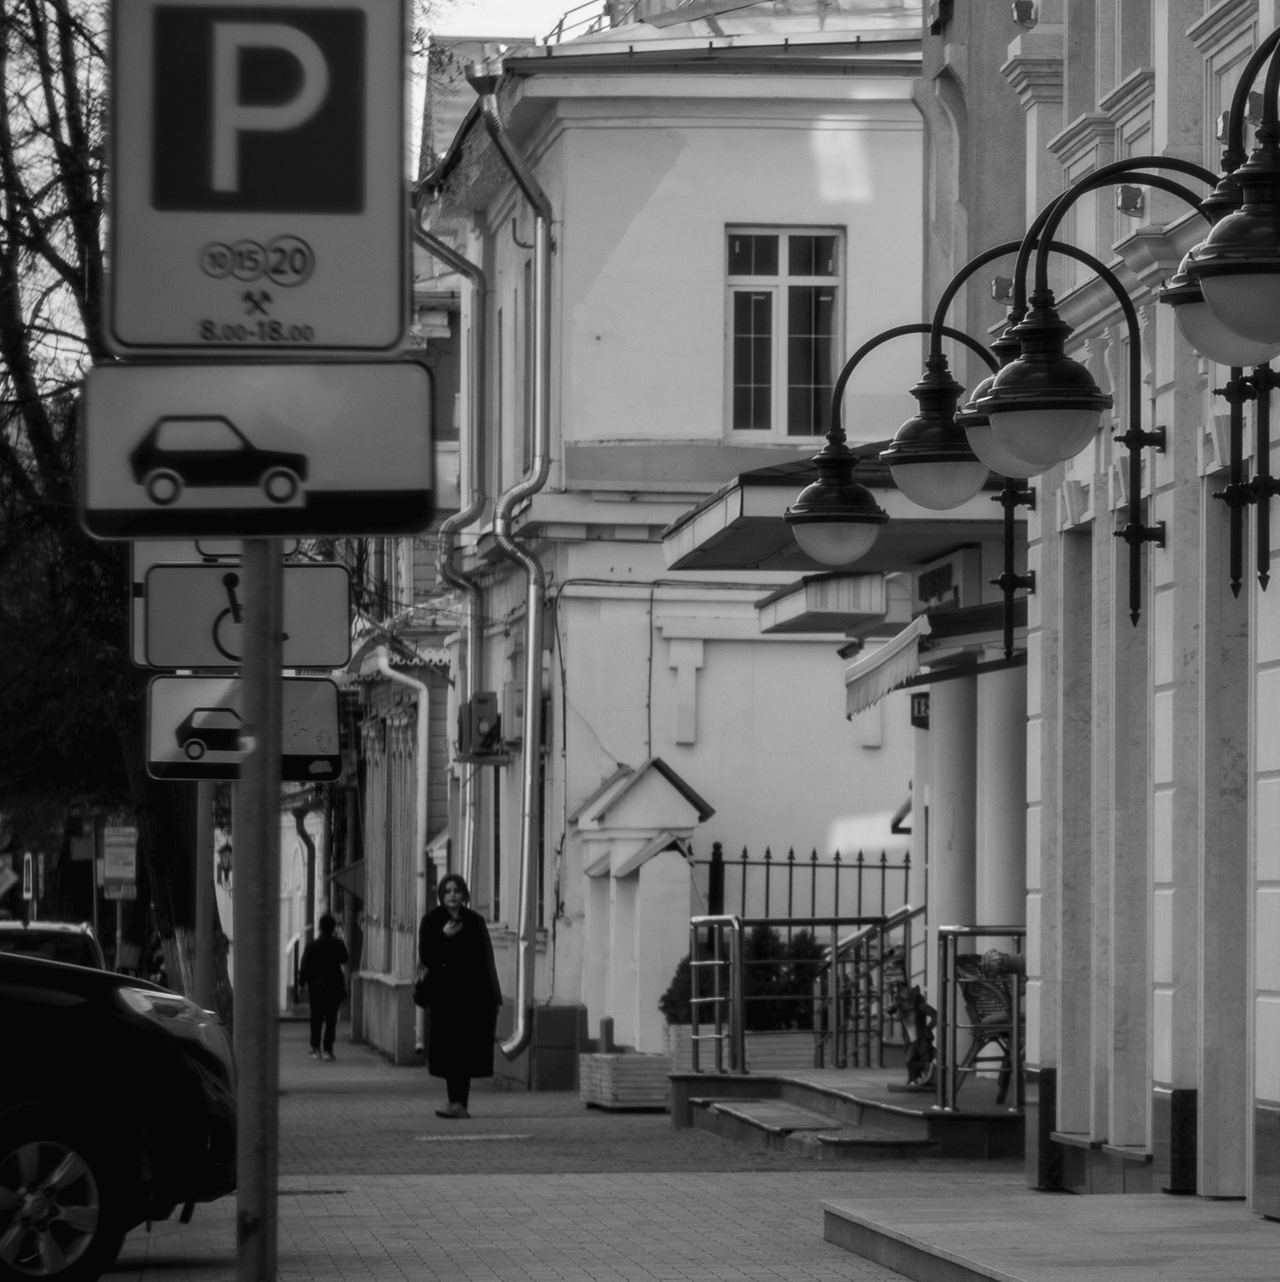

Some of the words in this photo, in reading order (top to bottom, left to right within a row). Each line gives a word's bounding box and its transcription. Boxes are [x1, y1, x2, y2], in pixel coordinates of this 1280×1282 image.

[210, 20, 330, 193] P
[208, 251, 229, 269] 10
[236, 250, 260, 271] 15
[271, 247, 307, 275] 20
